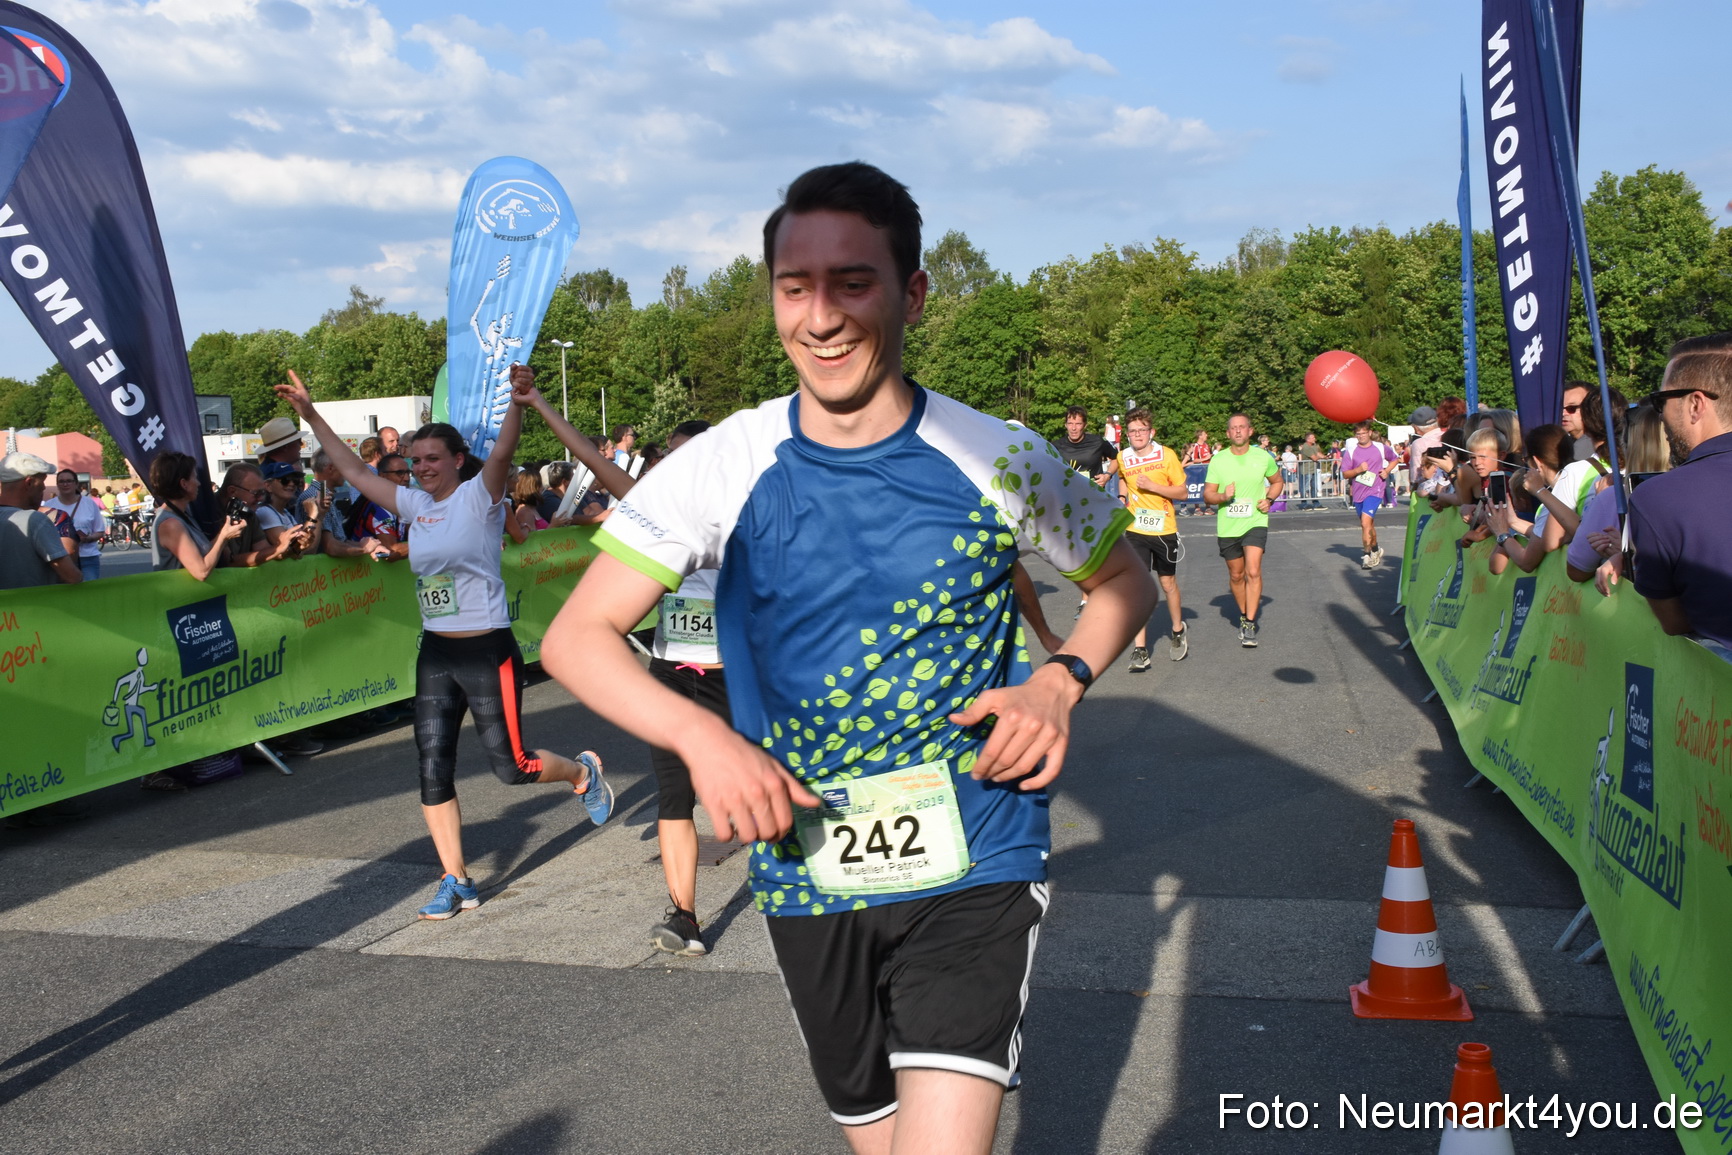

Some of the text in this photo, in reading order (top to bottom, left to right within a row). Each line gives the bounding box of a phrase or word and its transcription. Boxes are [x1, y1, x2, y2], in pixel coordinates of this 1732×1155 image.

[493, 215, 560, 242] WECHSELSZENE
[1125, 463, 1165, 477] MAX BÖGL
[1138, 516, 1160, 526] 1687
[269, 562, 373, 608] Gesunde Firmen
[302, 578, 386, 629] laufen länger!
[184, 619, 222, 640] Fischer
[669, 613, 713, 633] 1154
[192, 630, 223, 645] AUTOMOBILE
[157, 635, 286, 721] firmenlauf
[254, 674, 397, 728] www.firmenlauf-oberpfalz.de
[162, 703, 222, 738] neumarkt
[1630, 705, 1649, 735] Fischer
[916, 794, 944, 810] 2019
[833, 815, 926, 864] 242
[1602, 774, 1685, 905] firmenlauf
[842, 857, 931, 876] Mueller Patrick
[902, 872, 914, 880] SE
